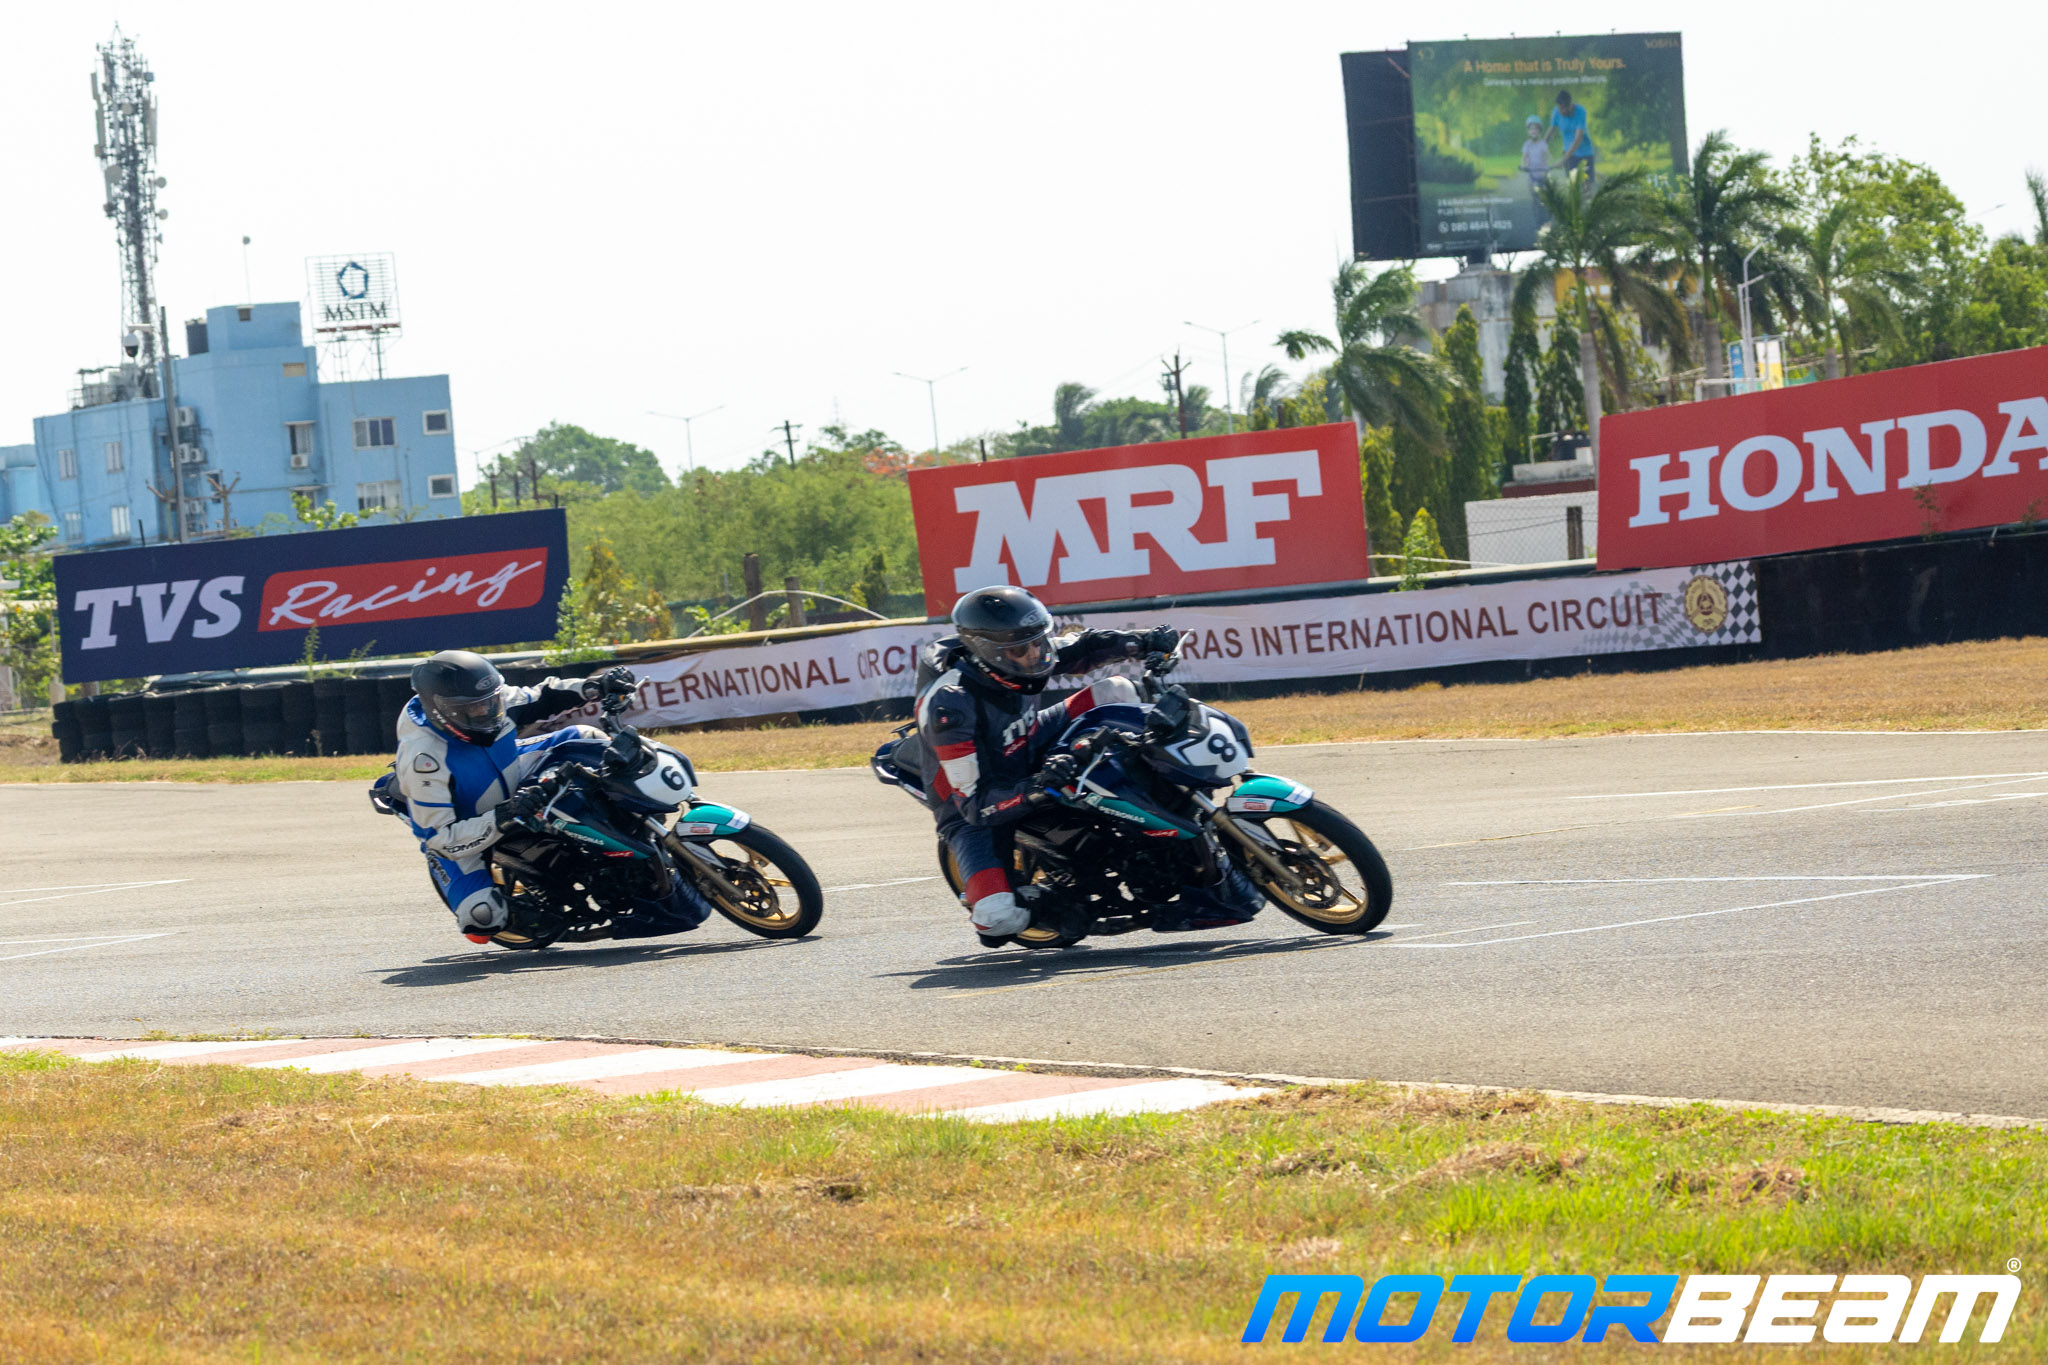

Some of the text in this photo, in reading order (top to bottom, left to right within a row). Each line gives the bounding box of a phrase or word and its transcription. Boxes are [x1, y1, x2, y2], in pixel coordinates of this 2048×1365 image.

[1463, 56, 1627, 73] A Home that is Truly Yours.
[324, 301, 387, 322] MSTM
[1629, 396, 2048, 528] HONDA
[953, 449, 1324, 594] MRF
[74, 560, 543, 651] TVS Racing
[1178, 627, 1243, 660] RAS
[1250, 604, 1519, 657] INTERNATIONAL
[1527, 592, 1663, 634] CIRCUIT
[628, 656, 850, 712] TERNATIONAL
[1208, 733, 1237, 763] 8
[661, 765, 685, 791] 6
[1098, 805, 1146, 824] PETRONAS
